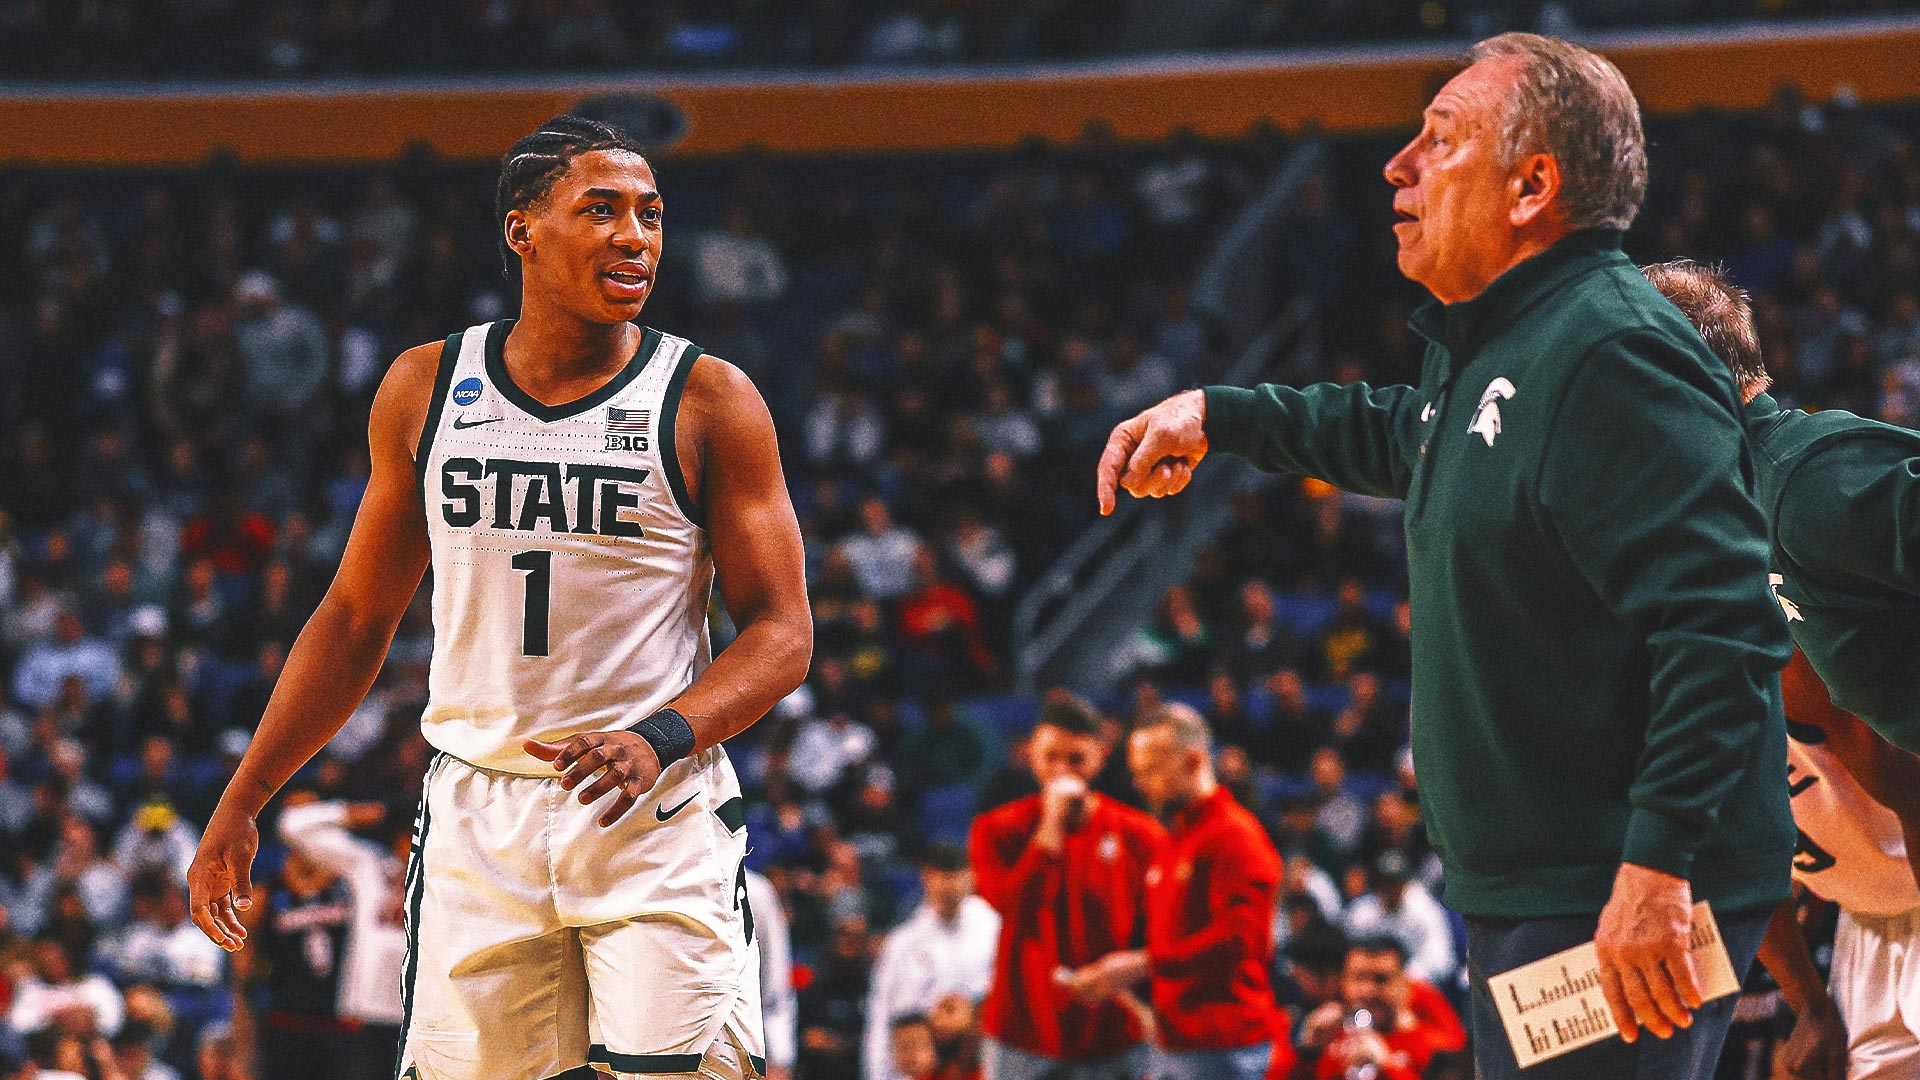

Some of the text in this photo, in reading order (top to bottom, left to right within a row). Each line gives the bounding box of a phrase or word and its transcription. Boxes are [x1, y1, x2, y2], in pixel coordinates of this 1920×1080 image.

[454, 389, 480, 400] NCAA
[605, 435, 649, 452] B1G
[441, 457, 651, 537] STATE
[511, 550, 552, 657] 1
